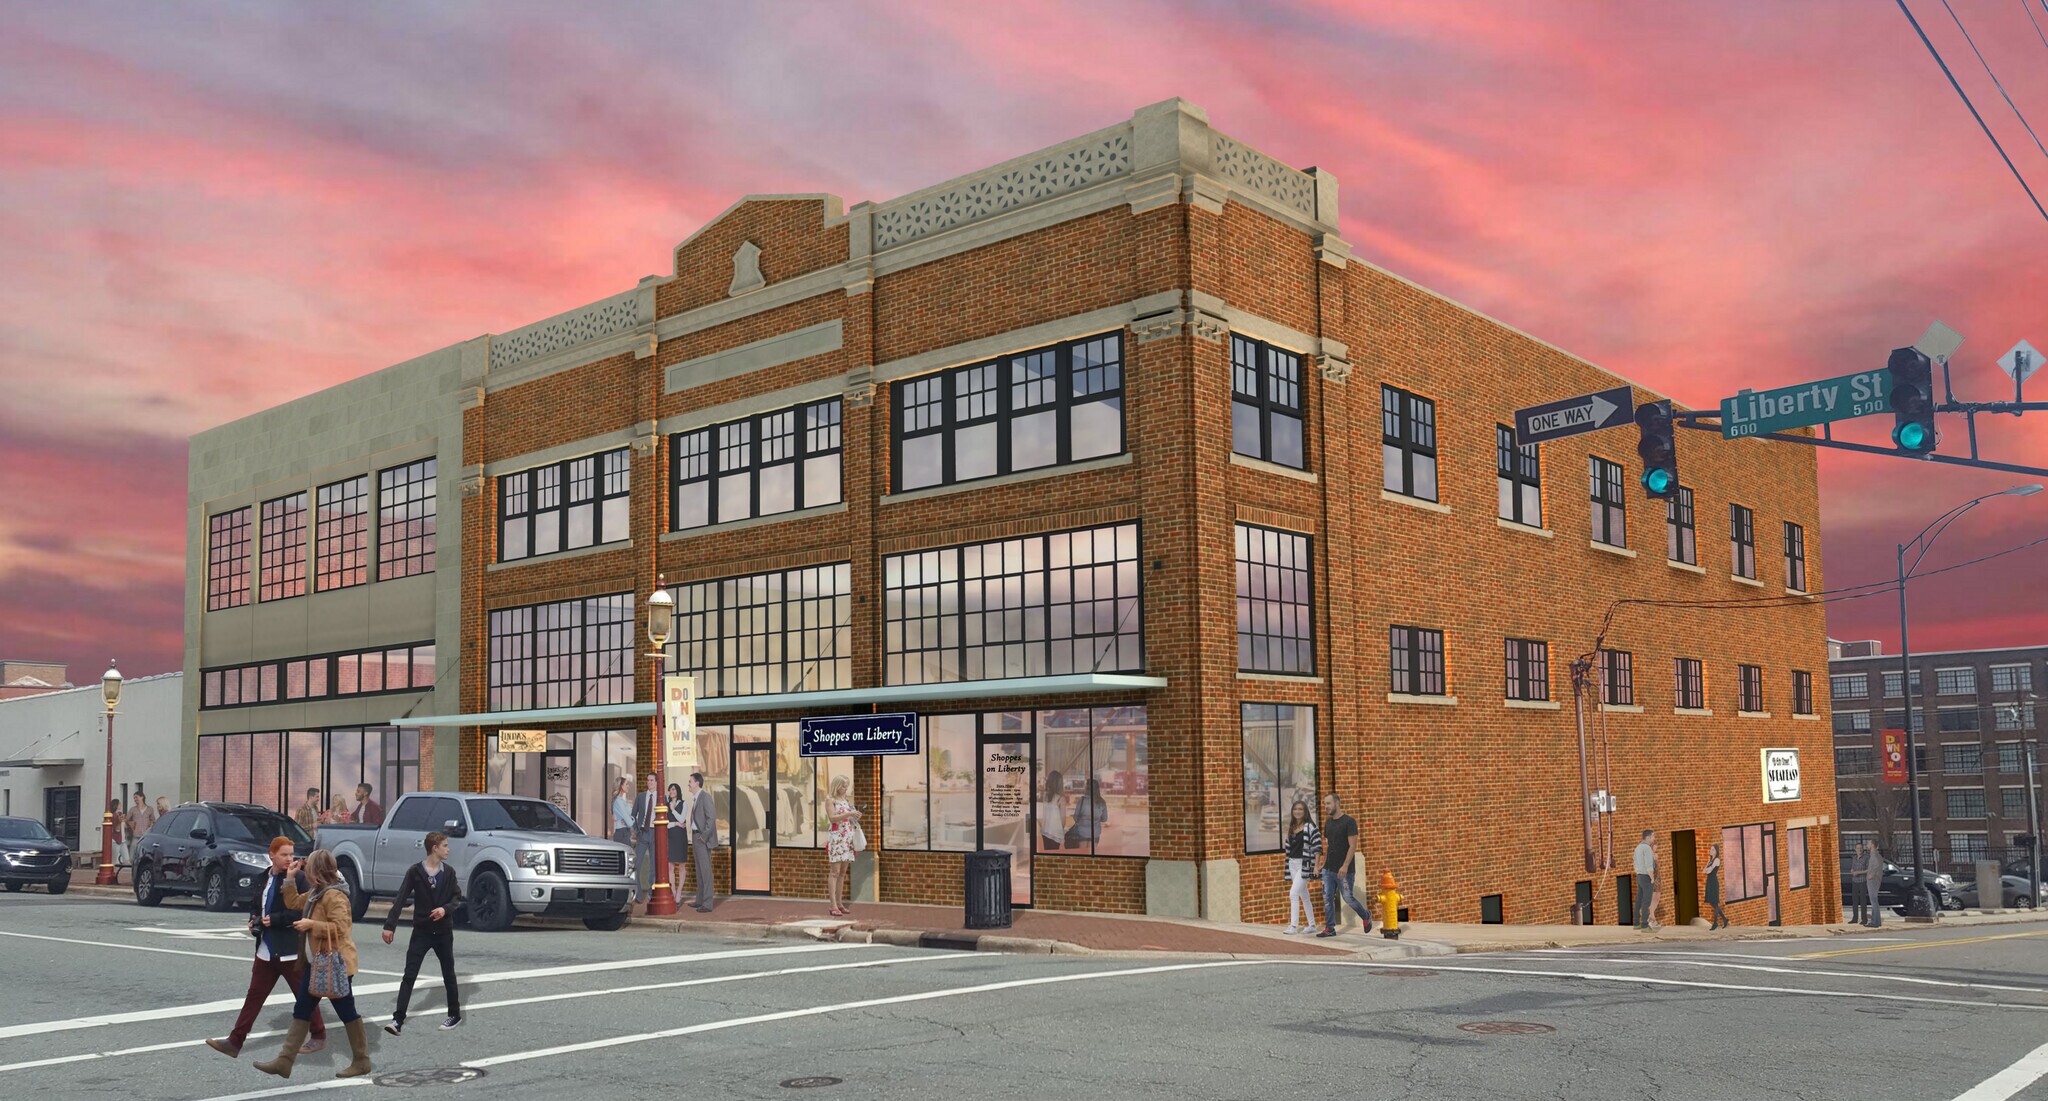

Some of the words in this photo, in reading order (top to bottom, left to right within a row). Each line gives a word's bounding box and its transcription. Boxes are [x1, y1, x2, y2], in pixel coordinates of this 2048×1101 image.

[1731, 385, 1838, 423] Liberty
[1851, 373, 1883, 401] St
[1854, 400, 1883, 416] 500
[1532, 413, 1560, 431] ONE
[1565, 405, 1594, 424] WAY
[1731, 423, 1757, 437] 600
[813, 729, 850, 746] Shoppes
[852, 732, 863, 741] on
[867, 726, 902, 744] Liberty
[991, 753, 1022, 763] Shoppes
[998, 765, 1026, 774] Liberty
